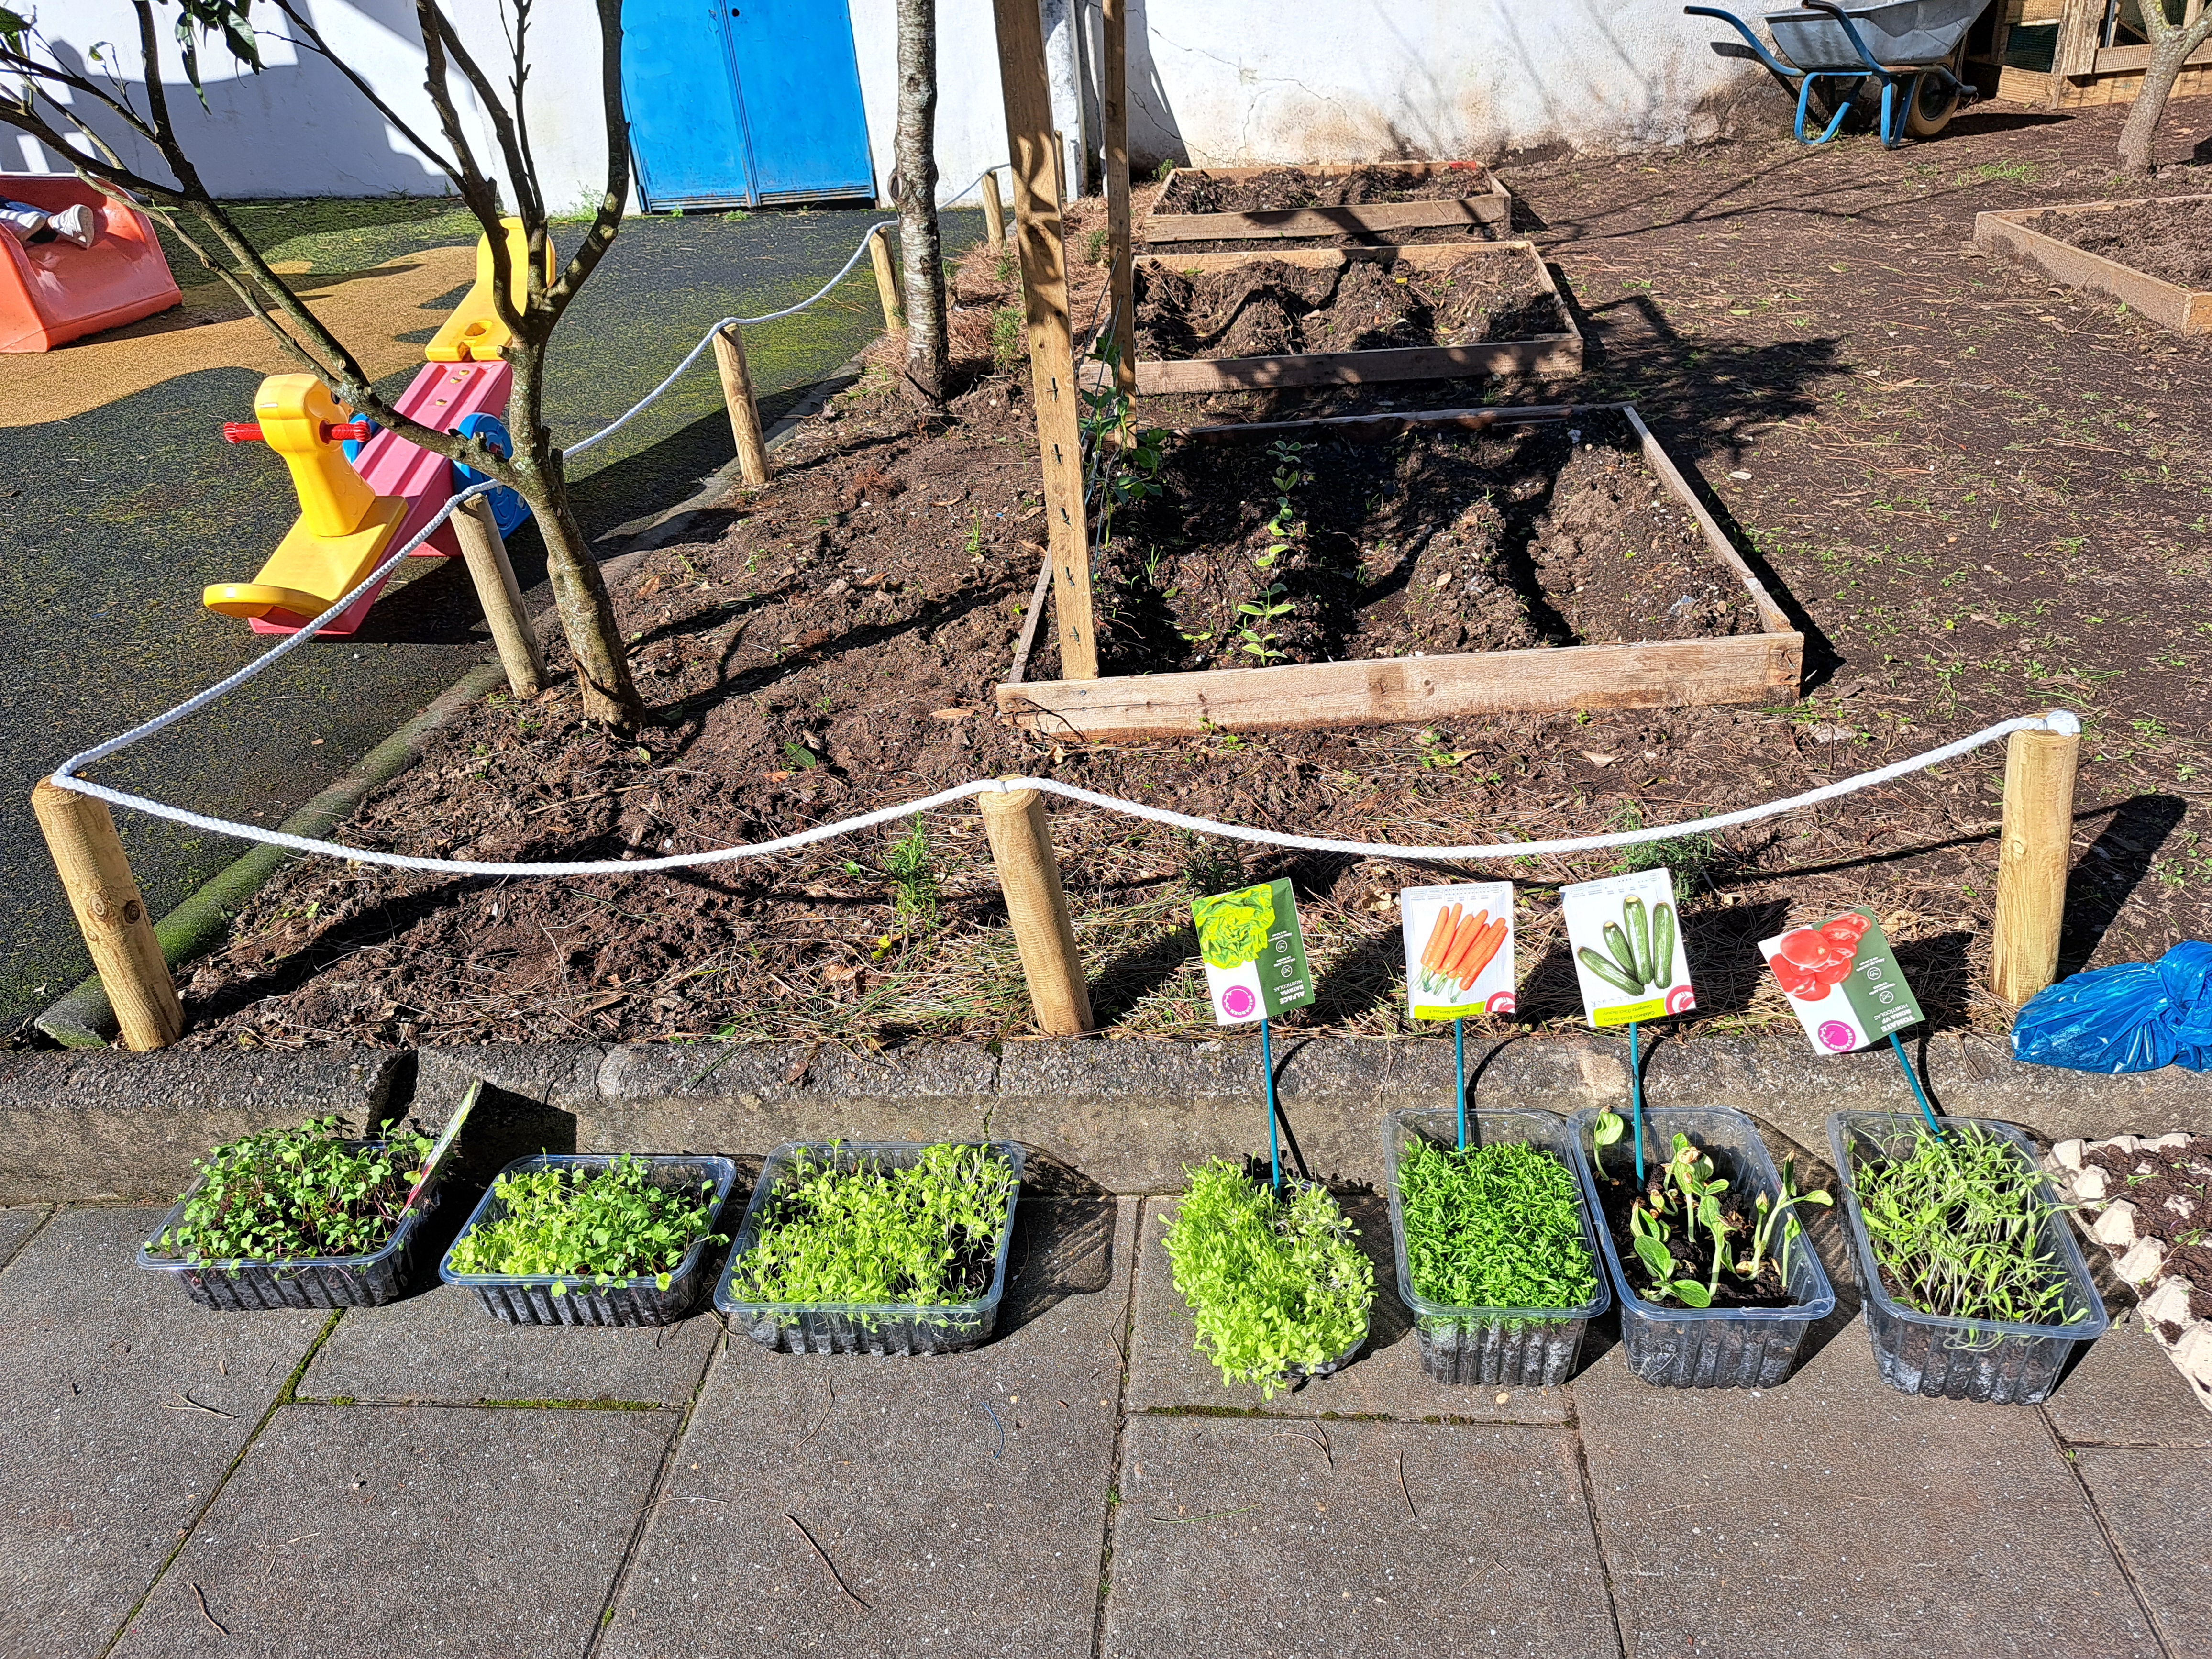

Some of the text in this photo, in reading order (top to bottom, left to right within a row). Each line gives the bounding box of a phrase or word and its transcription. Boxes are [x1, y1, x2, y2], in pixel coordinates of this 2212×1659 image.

[1273, 978, 1303, 992] HORTÍCOLAS
[1280, 984, 1304, 996] BATAVIA
[1279, 991, 1305, 1004] ALFACE
[1230, 995, 1253, 1016] DELGARDEN
[1874, 1003, 1909, 1020] HORTÍCOLAS
[1890, 1008, 1912, 1019] ROMA
[1880, 1015, 1915, 1032] TOMATE
[1830, 1029, 1854, 1050] DELGARDEN
